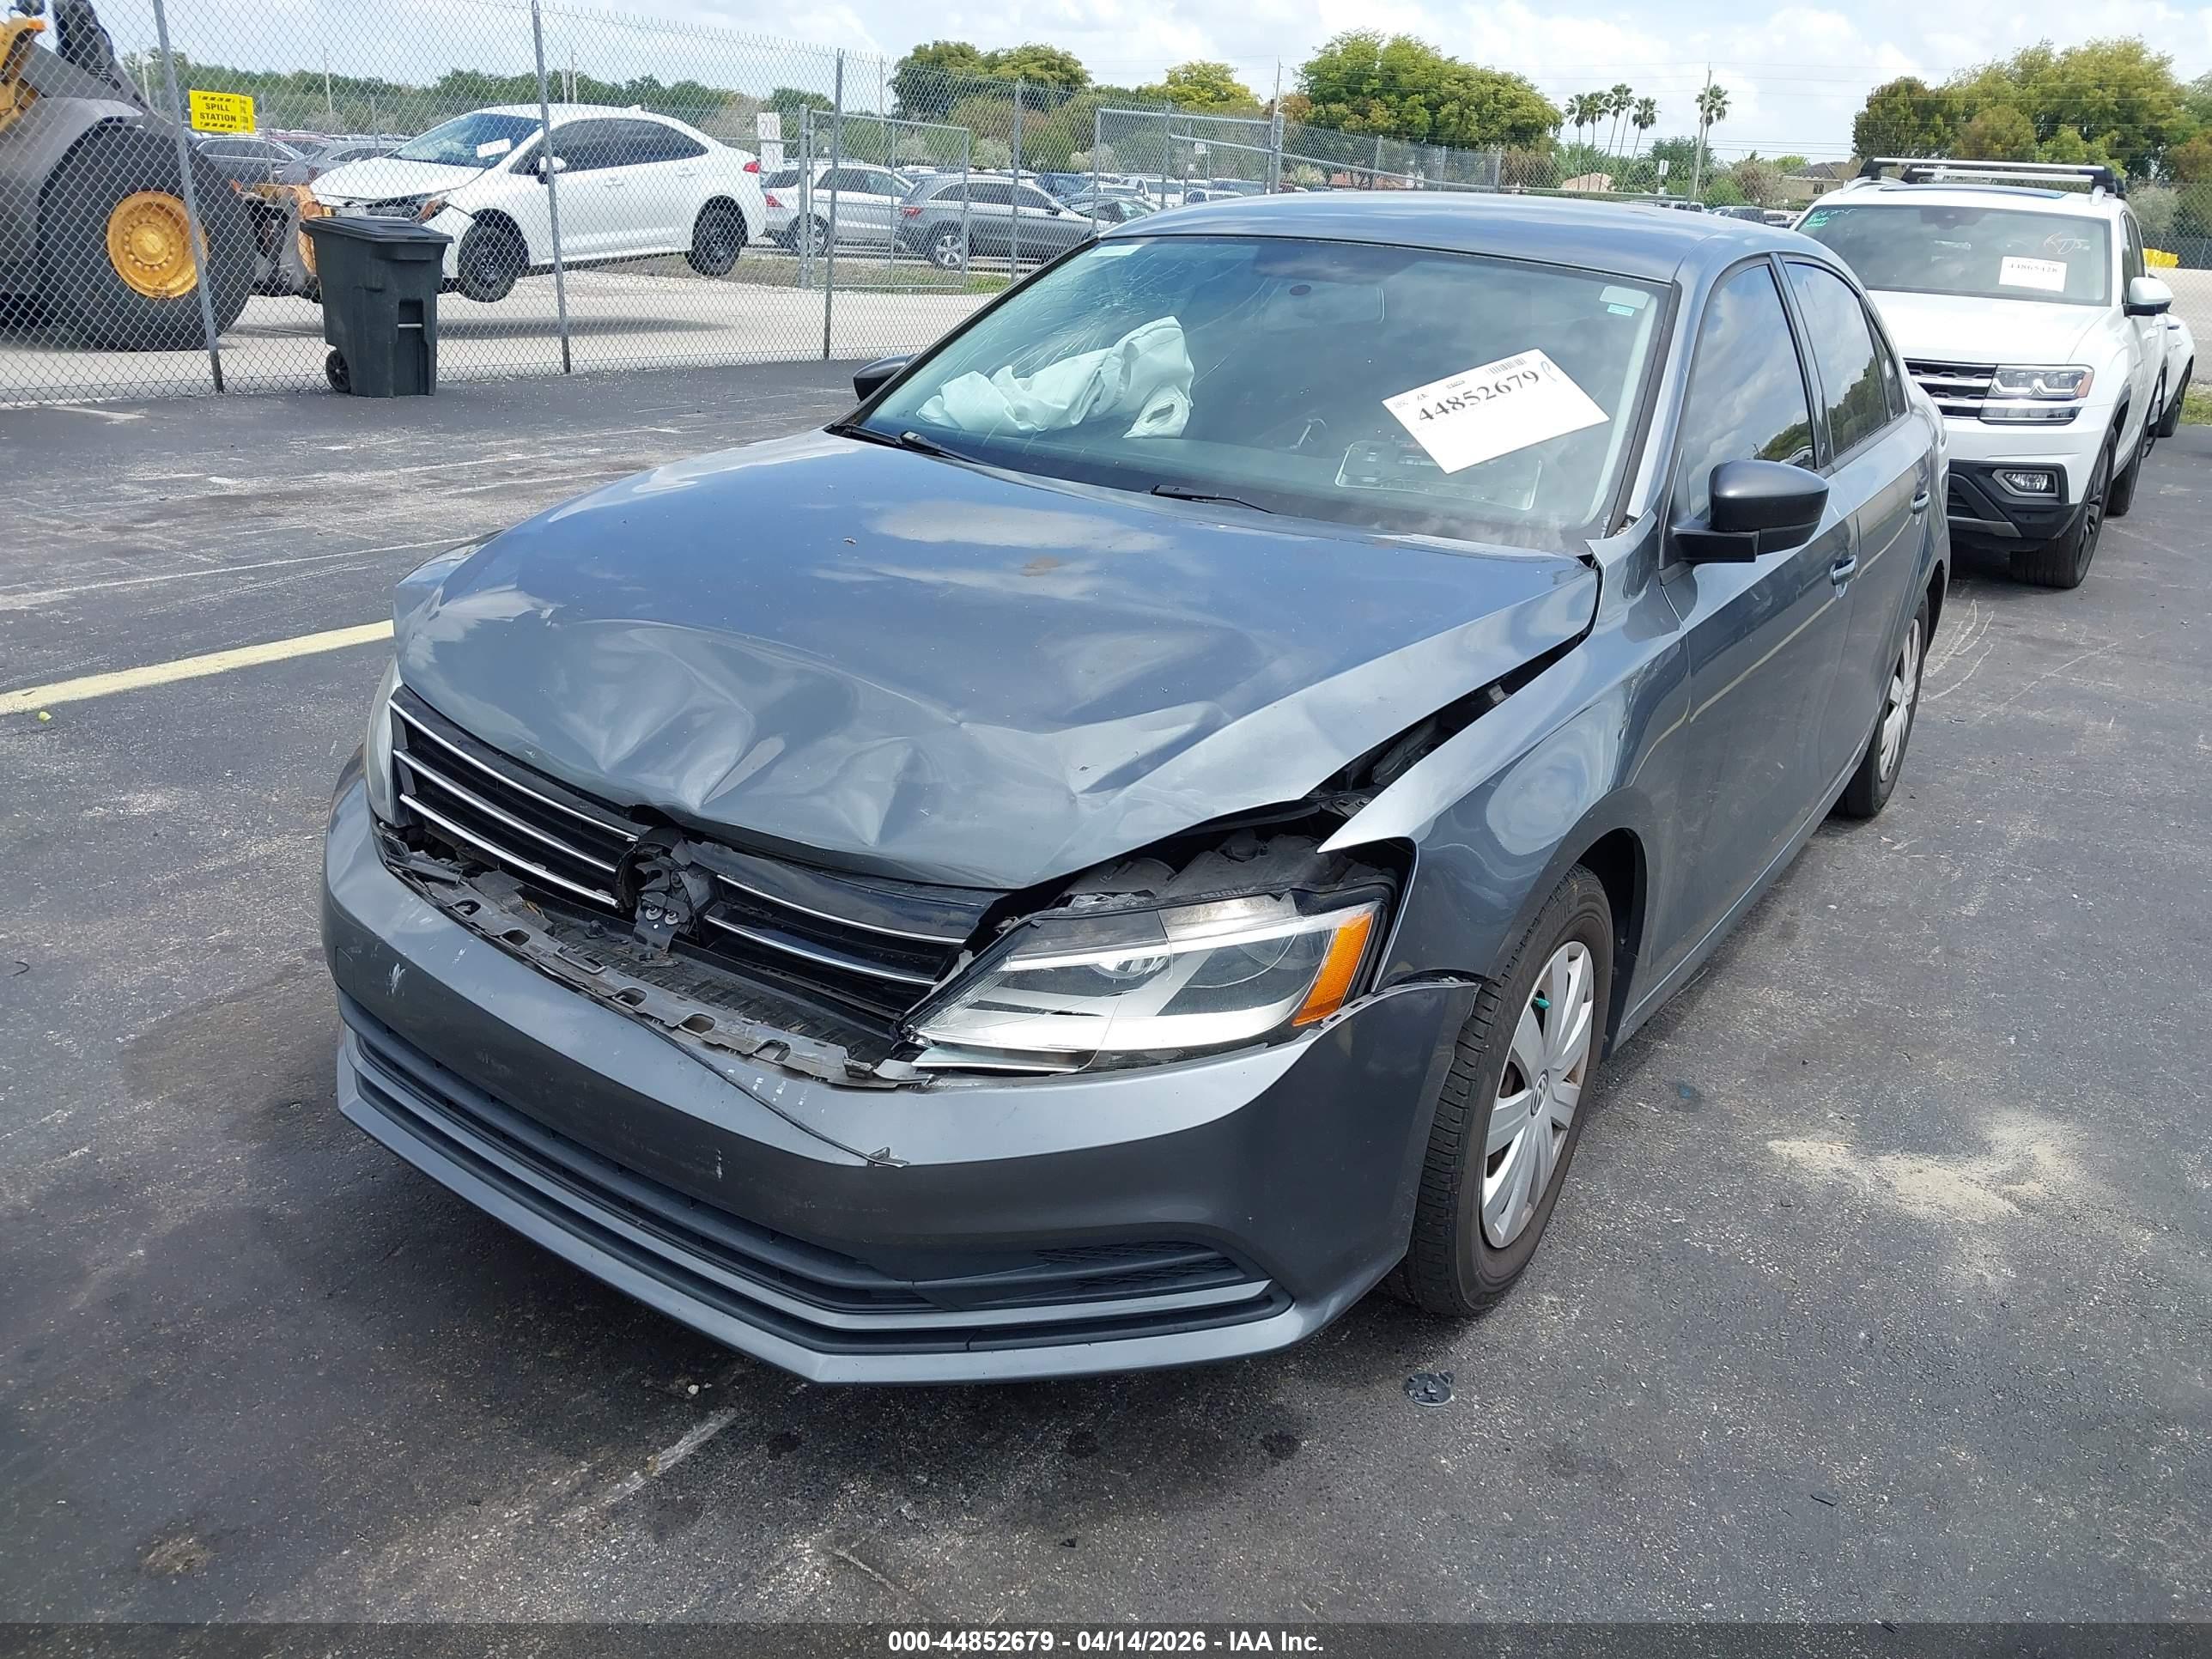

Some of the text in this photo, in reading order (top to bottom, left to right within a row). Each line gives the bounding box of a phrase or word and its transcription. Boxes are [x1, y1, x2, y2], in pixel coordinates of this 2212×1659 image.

[205, 102, 230, 112] SPILL
[199, 112, 237, 122] STATION
[1419, 370, 1540, 421] 44852679
